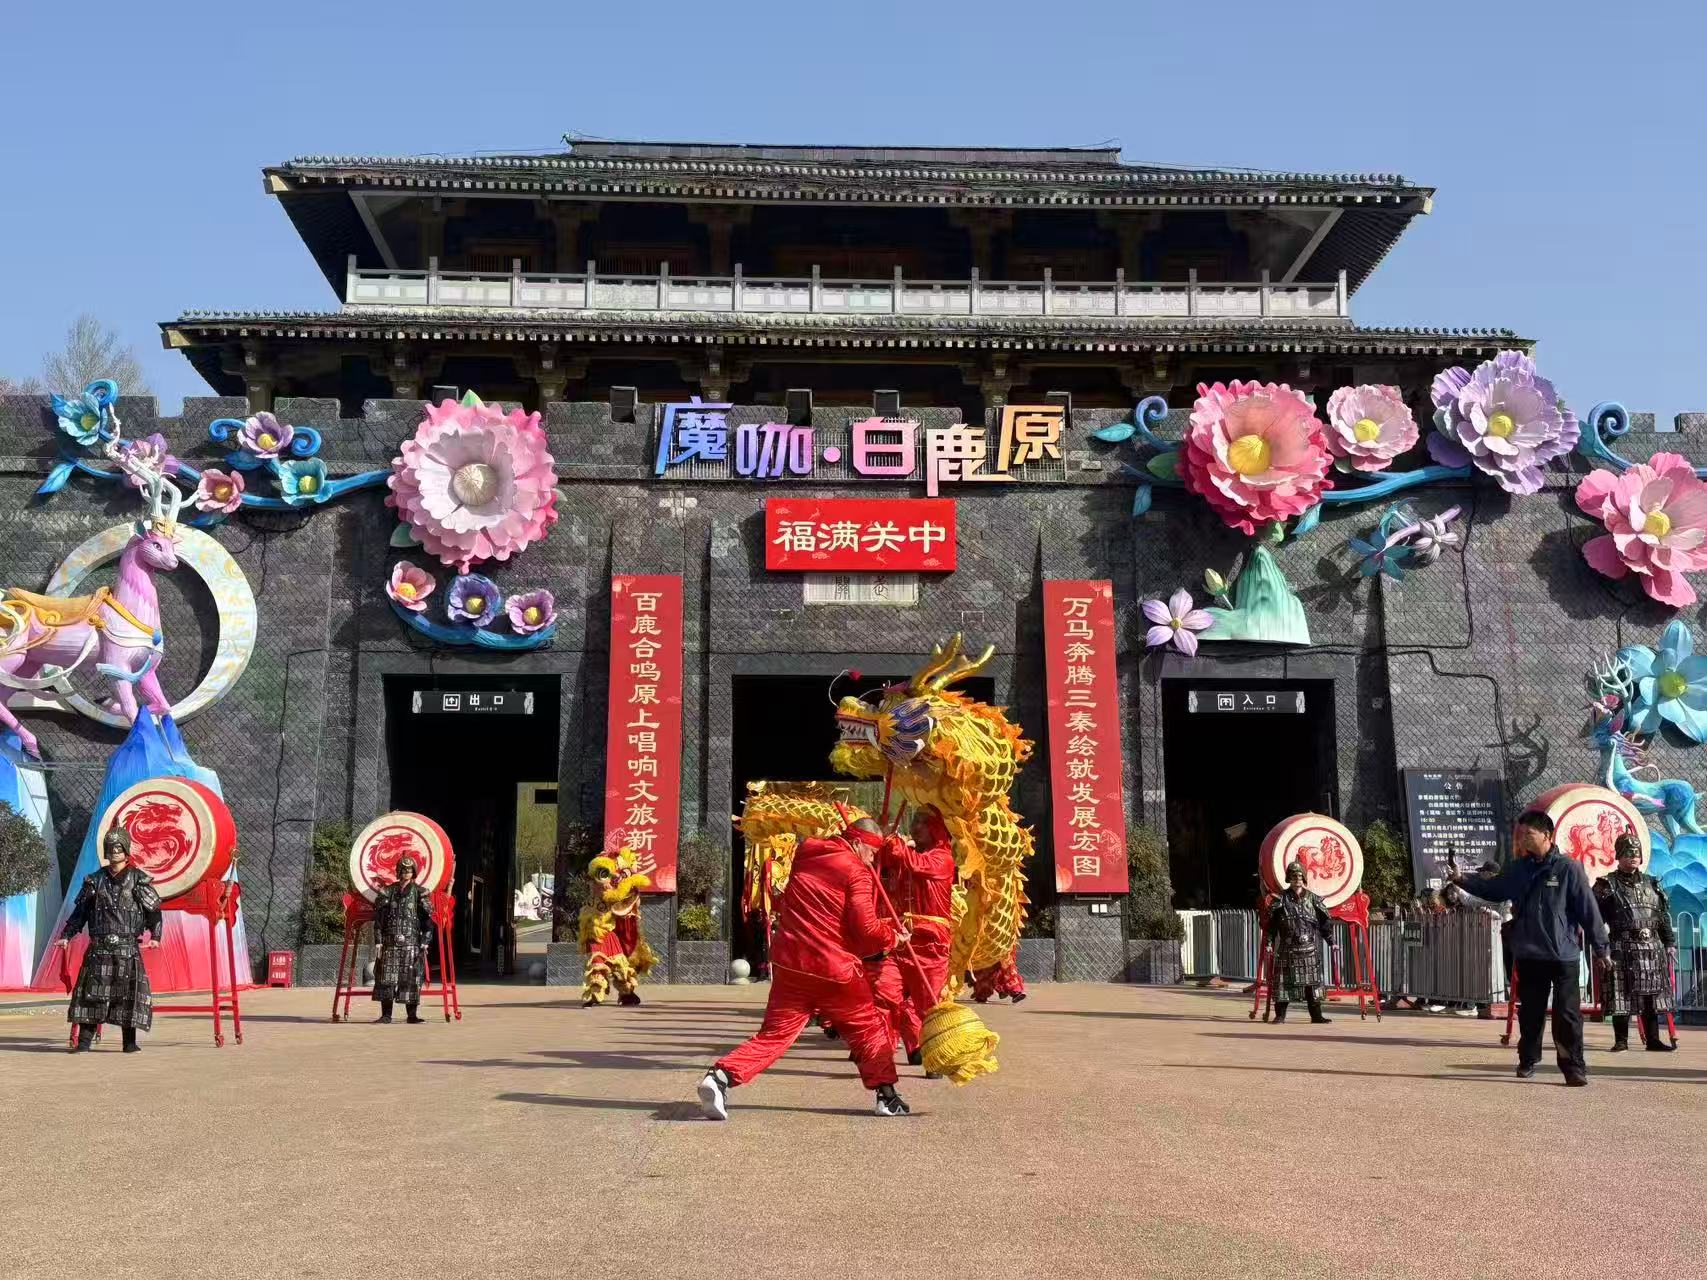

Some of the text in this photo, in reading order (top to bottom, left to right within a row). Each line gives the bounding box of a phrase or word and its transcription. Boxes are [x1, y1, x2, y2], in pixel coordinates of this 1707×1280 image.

[655, 396, 1065, 497] 魔咖·白鹿原
[773, 520, 946, 553] 福满关中
[469, 693, 504, 706] 出口
[1242, 693, 1276, 705] 入口
[1062, 597, 1101, 877] 万马奔腾三秦绘就发展宏图
